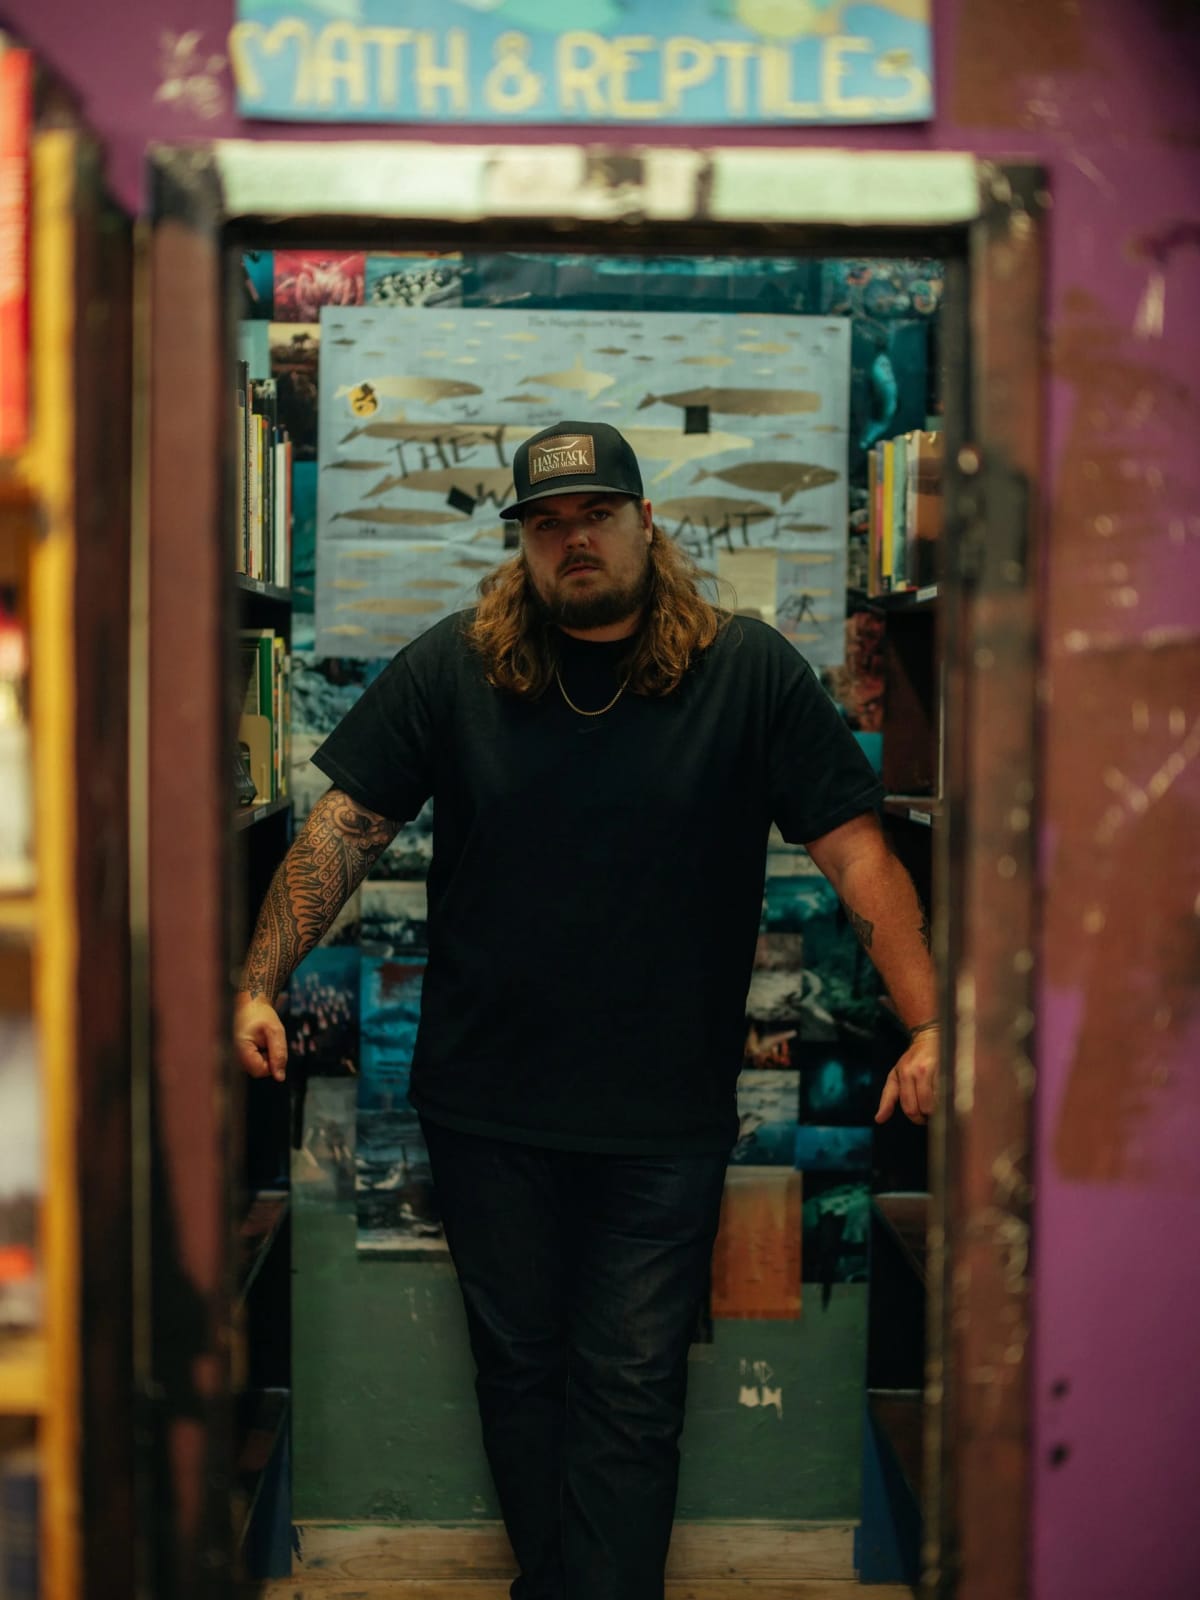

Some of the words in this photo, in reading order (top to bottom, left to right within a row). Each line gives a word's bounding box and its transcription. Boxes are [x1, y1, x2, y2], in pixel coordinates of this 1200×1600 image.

[230, 20, 467, 116] MATH
[484, 34, 542, 114] &
[555, 31, 932, 119] REPTILES
[386, 424, 511, 479] THEY
[533, 449, 590, 475] HAYSTACK
